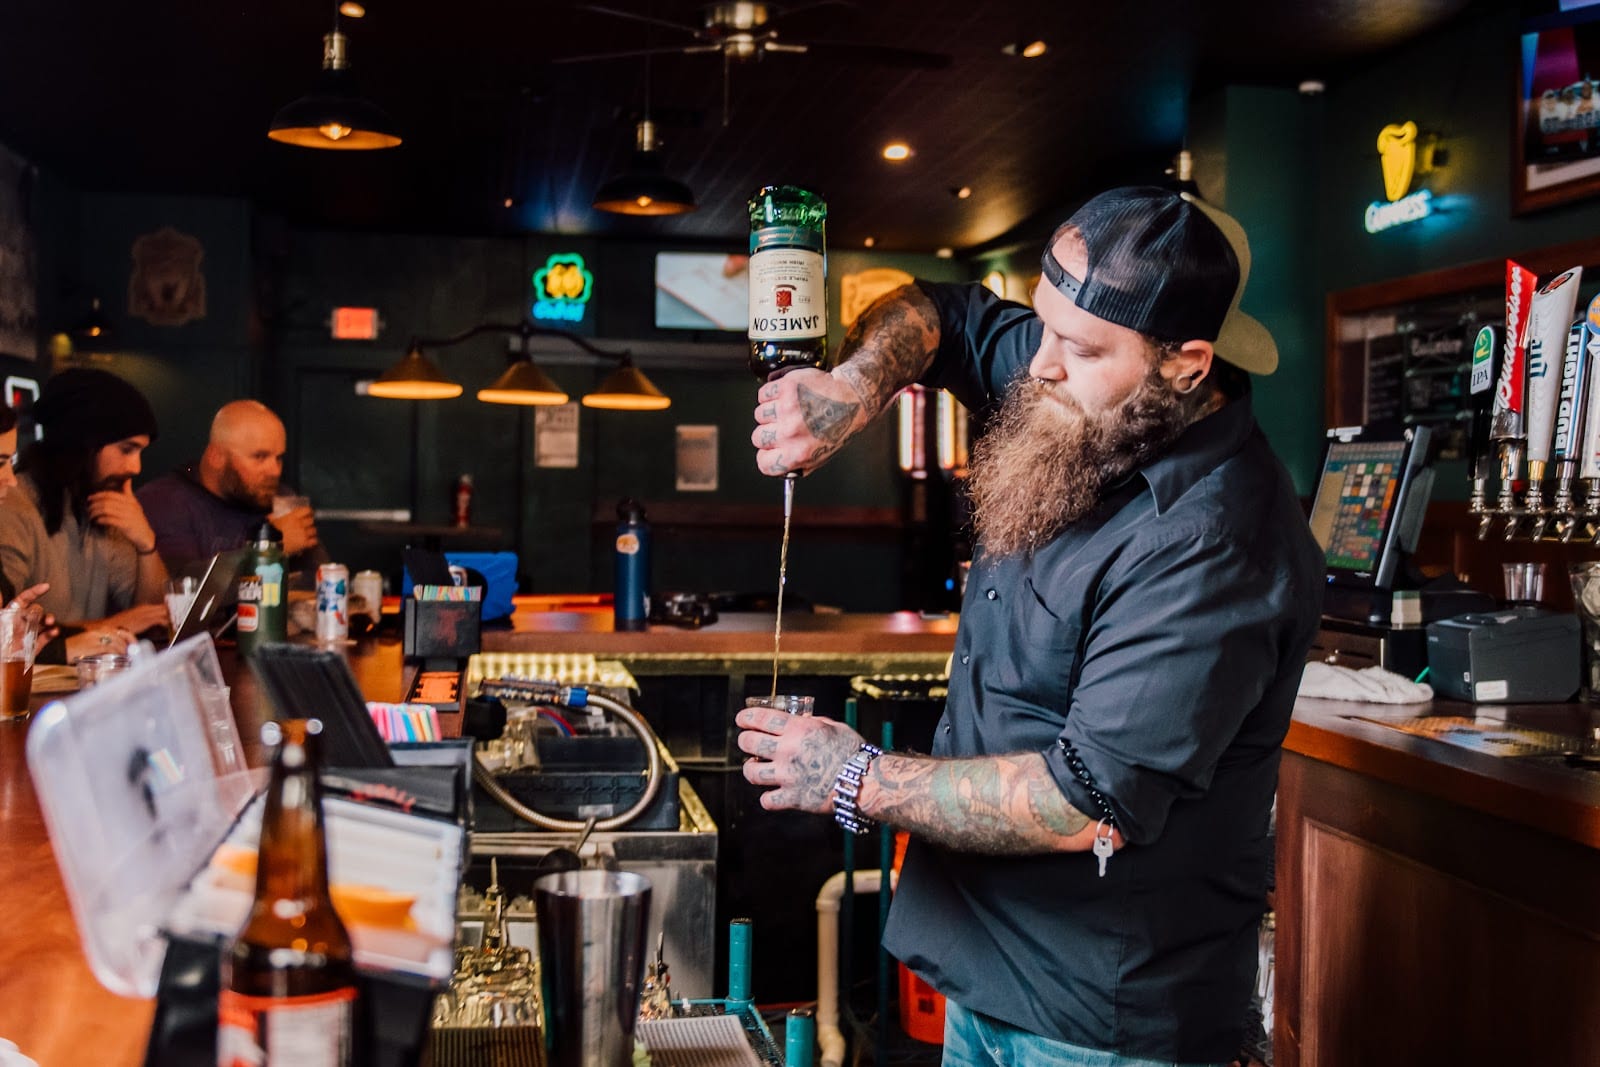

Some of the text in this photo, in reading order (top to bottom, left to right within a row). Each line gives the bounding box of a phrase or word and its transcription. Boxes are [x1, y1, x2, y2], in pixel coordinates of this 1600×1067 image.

[753, 315, 819, 330] JAMESON
[1493, 266, 1523, 416] Budweiser
[1472, 371, 1489, 387] IPA
[1555, 333, 1580, 450] BUD LIGHT
